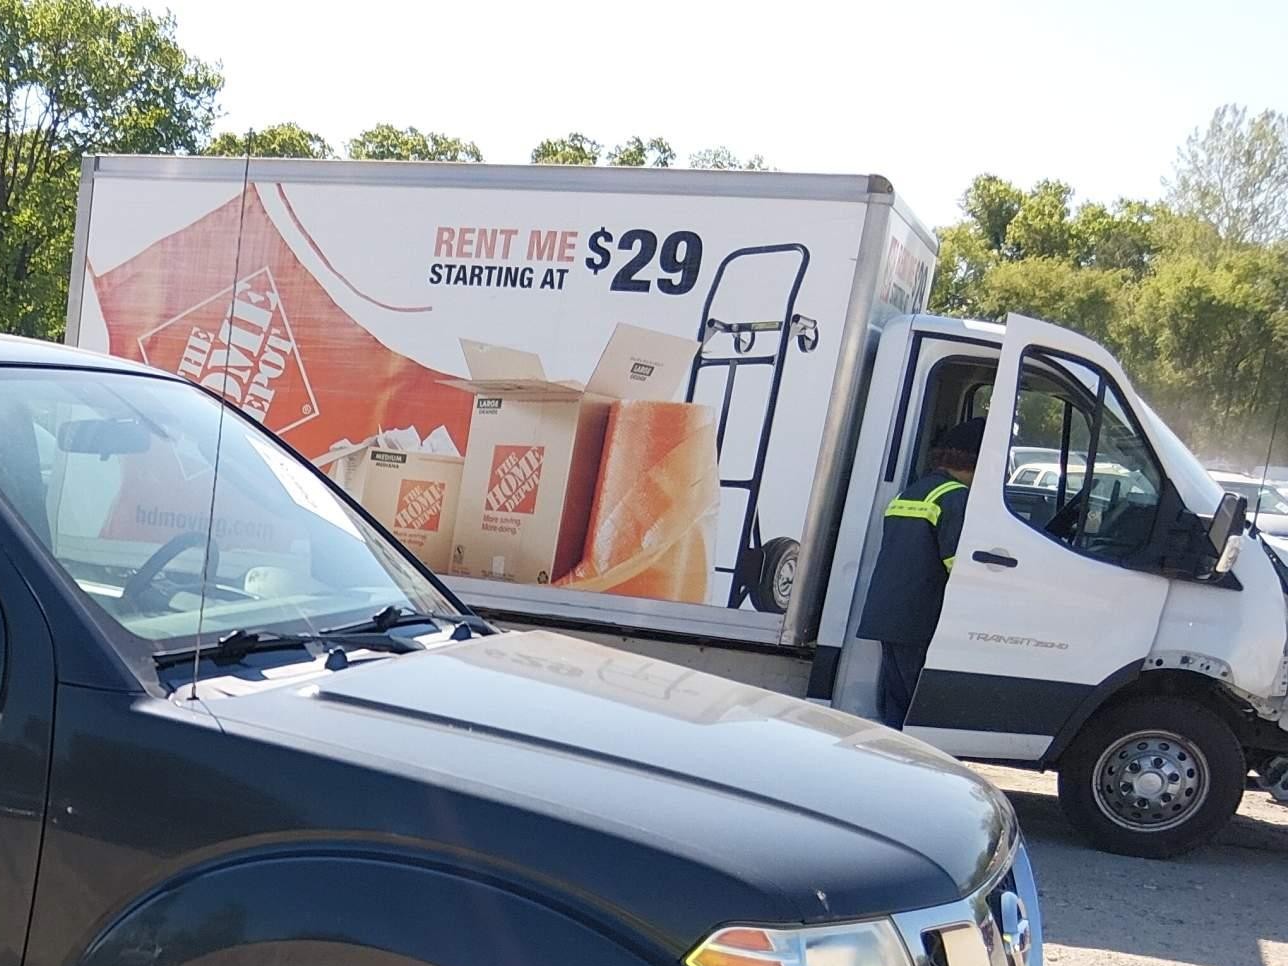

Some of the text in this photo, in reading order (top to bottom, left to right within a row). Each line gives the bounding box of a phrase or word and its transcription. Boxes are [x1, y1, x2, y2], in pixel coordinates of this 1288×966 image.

[433, 226, 703, 296] RENT ME $29
[429, 263, 569, 290] STARTING AT
[240, 328, 294, 424] EPOT
[375, 453, 403, 462] MEDIUM
[494, 452, 518, 478] THE
[487, 448, 543, 510] HOME
[504, 471, 539, 512] DEPOT
[396, 482, 443, 528] HOME
[403, 485, 424, 504] THE
[412, 501, 441, 529] DEPOT
[968, 632, 1034, 646] TRANSIT
